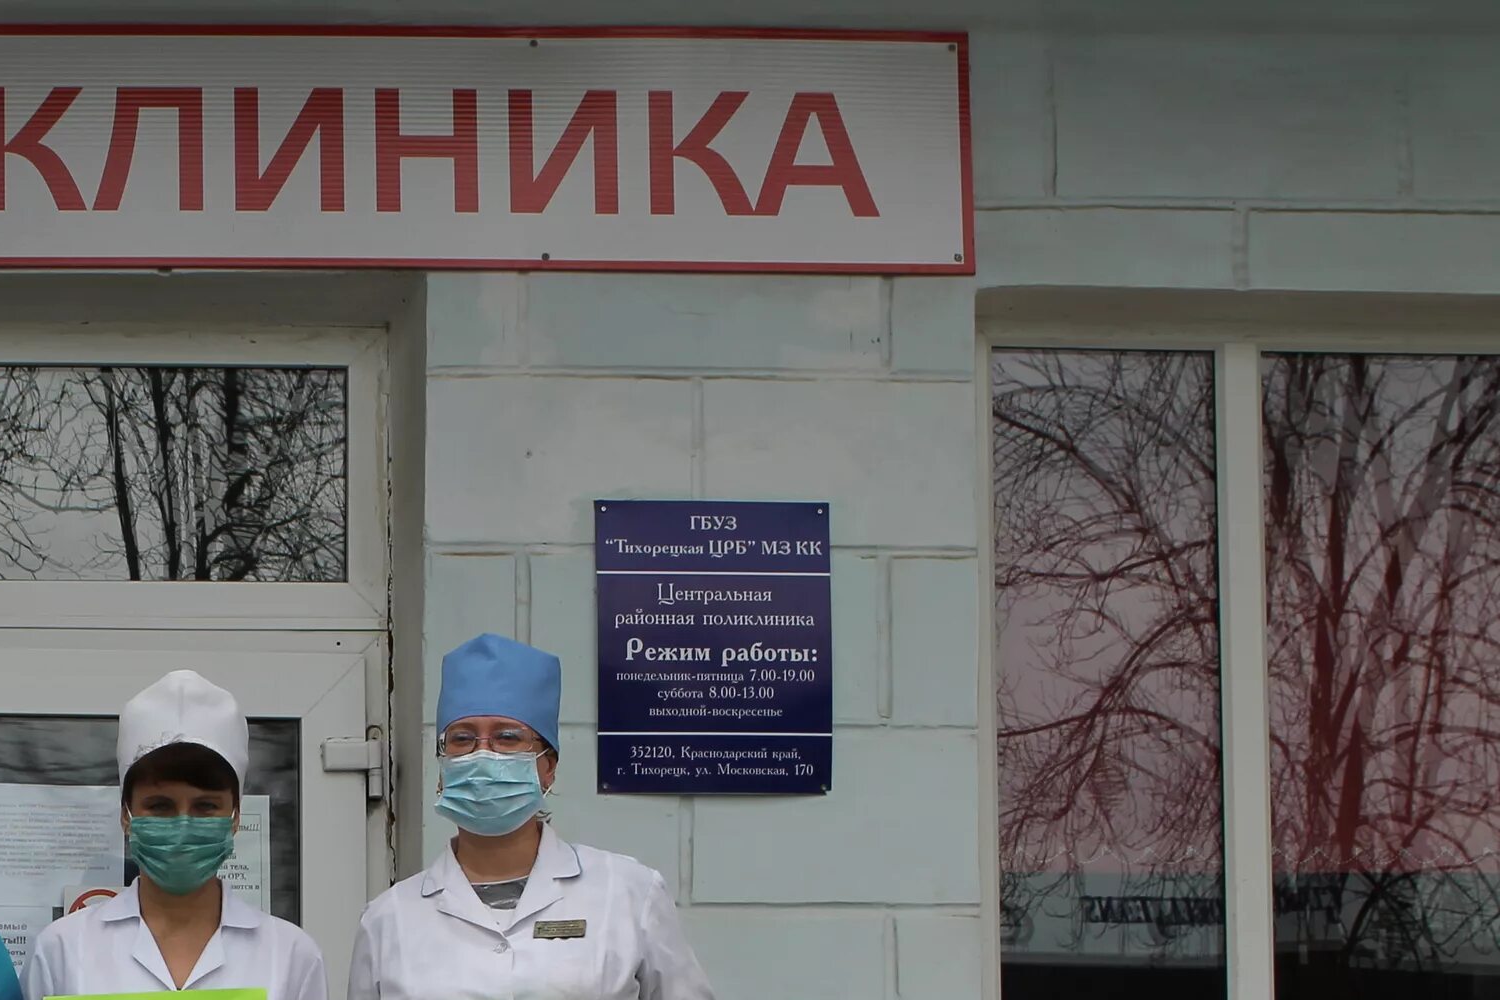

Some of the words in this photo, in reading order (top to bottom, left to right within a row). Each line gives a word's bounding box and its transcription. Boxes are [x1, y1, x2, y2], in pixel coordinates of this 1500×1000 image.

[689, 515, 737, 531] ГБУЗ
[761, 540, 791, 556] МЗ
[795, 540, 823, 556] КК
[656, 582, 772, 606] Центральная
[614, 608, 695, 629] районная
[702, 613, 815, 627] поликлиника
[625, 637, 711, 661] Режим
[721, 642, 819, 667] работы:
[616, 672, 744, 684] понедельник-пятница
[749, 668, 815, 682] 7.00-19.00
[657, 687, 704, 701] суббота
[708, 685, 775, 699] 8.00-13.00
[649, 704, 783, 719] выходной-воскресенье
[630, 745, 676, 759] 352120,
[681, 745, 768, 761] Краснодарский
[772, 747, 801, 761] край,
[617, 767, 626, 775] г.
[630, 762, 690, 778] Тихорецк,
[695, 767, 712, 777] ул.
[717, 763, 789, 776] Московская,
[794, 764, 814, 776] 170
